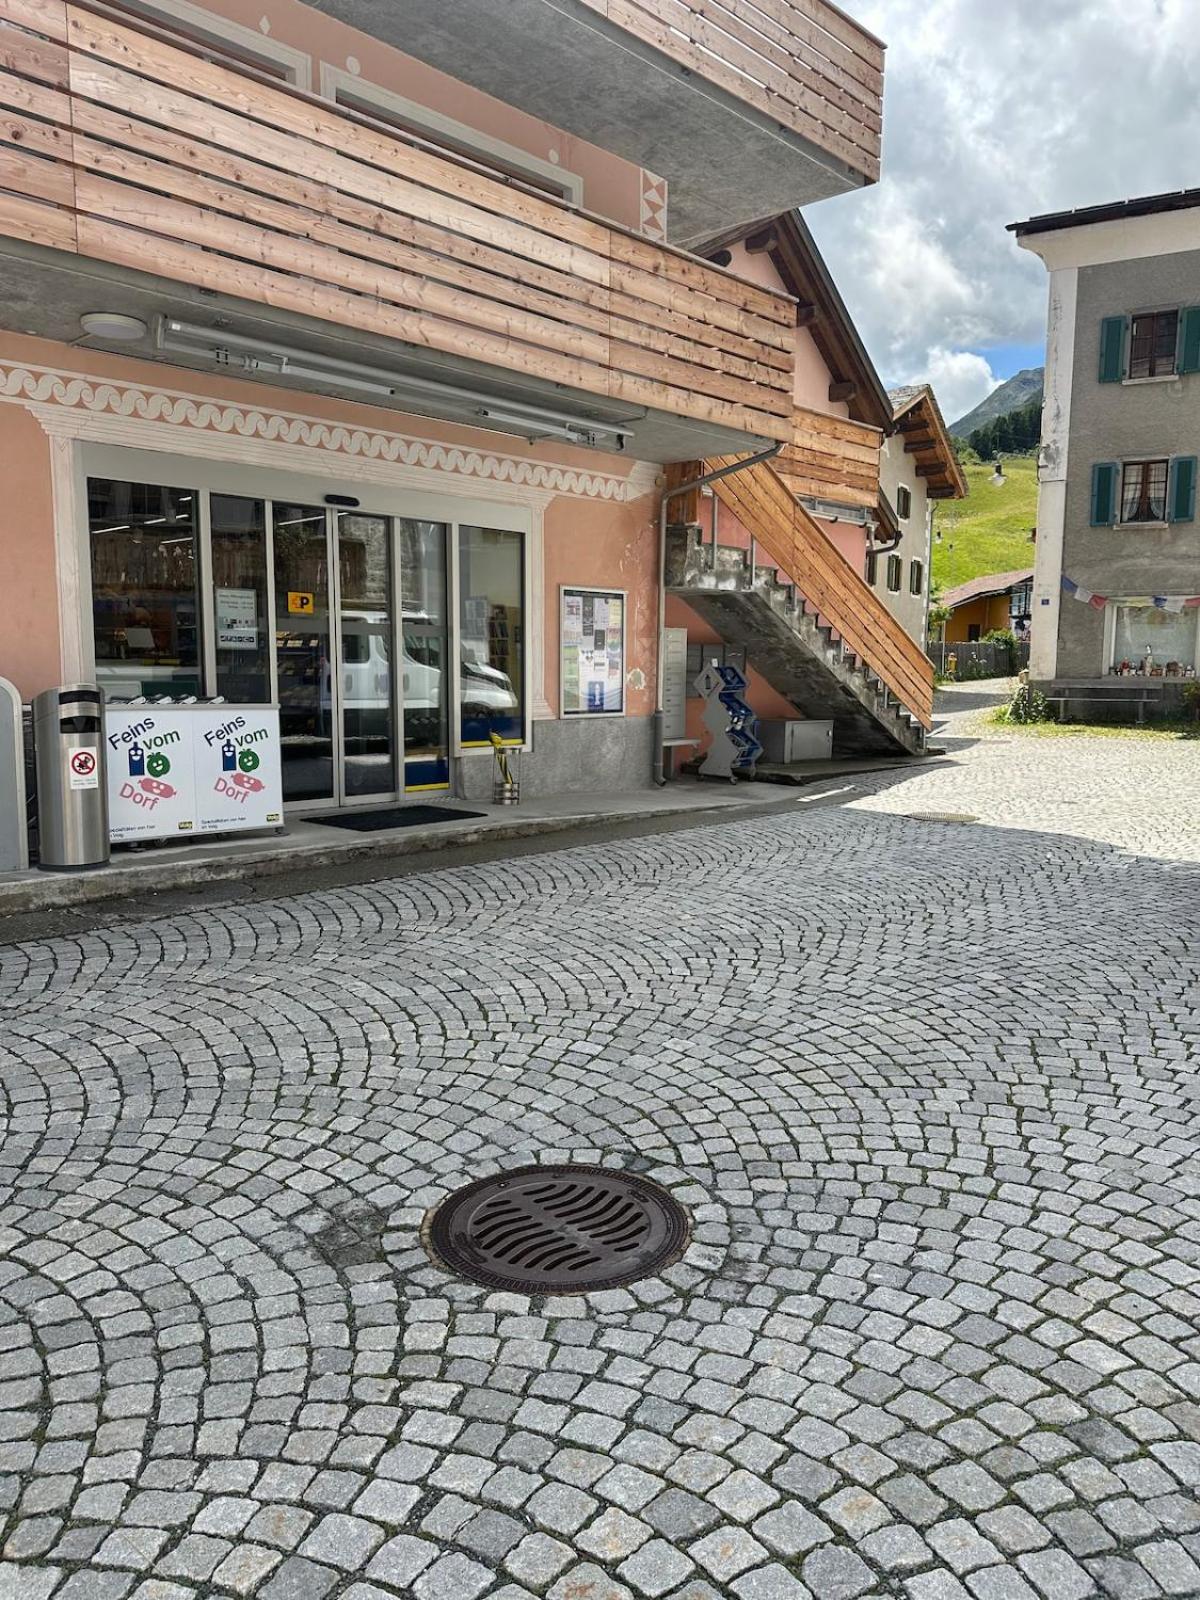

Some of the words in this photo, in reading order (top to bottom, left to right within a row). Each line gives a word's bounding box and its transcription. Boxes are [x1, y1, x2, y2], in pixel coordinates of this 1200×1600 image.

[108, 718, 155, 750] Feins
[143, 731, 181, 750] vom
[204, 716, 246, 747] Feins
[235, 729, 268, 747] vom
[119, 783, 159, 810] Dorf
[214, 777, 250, 804] Dorf
